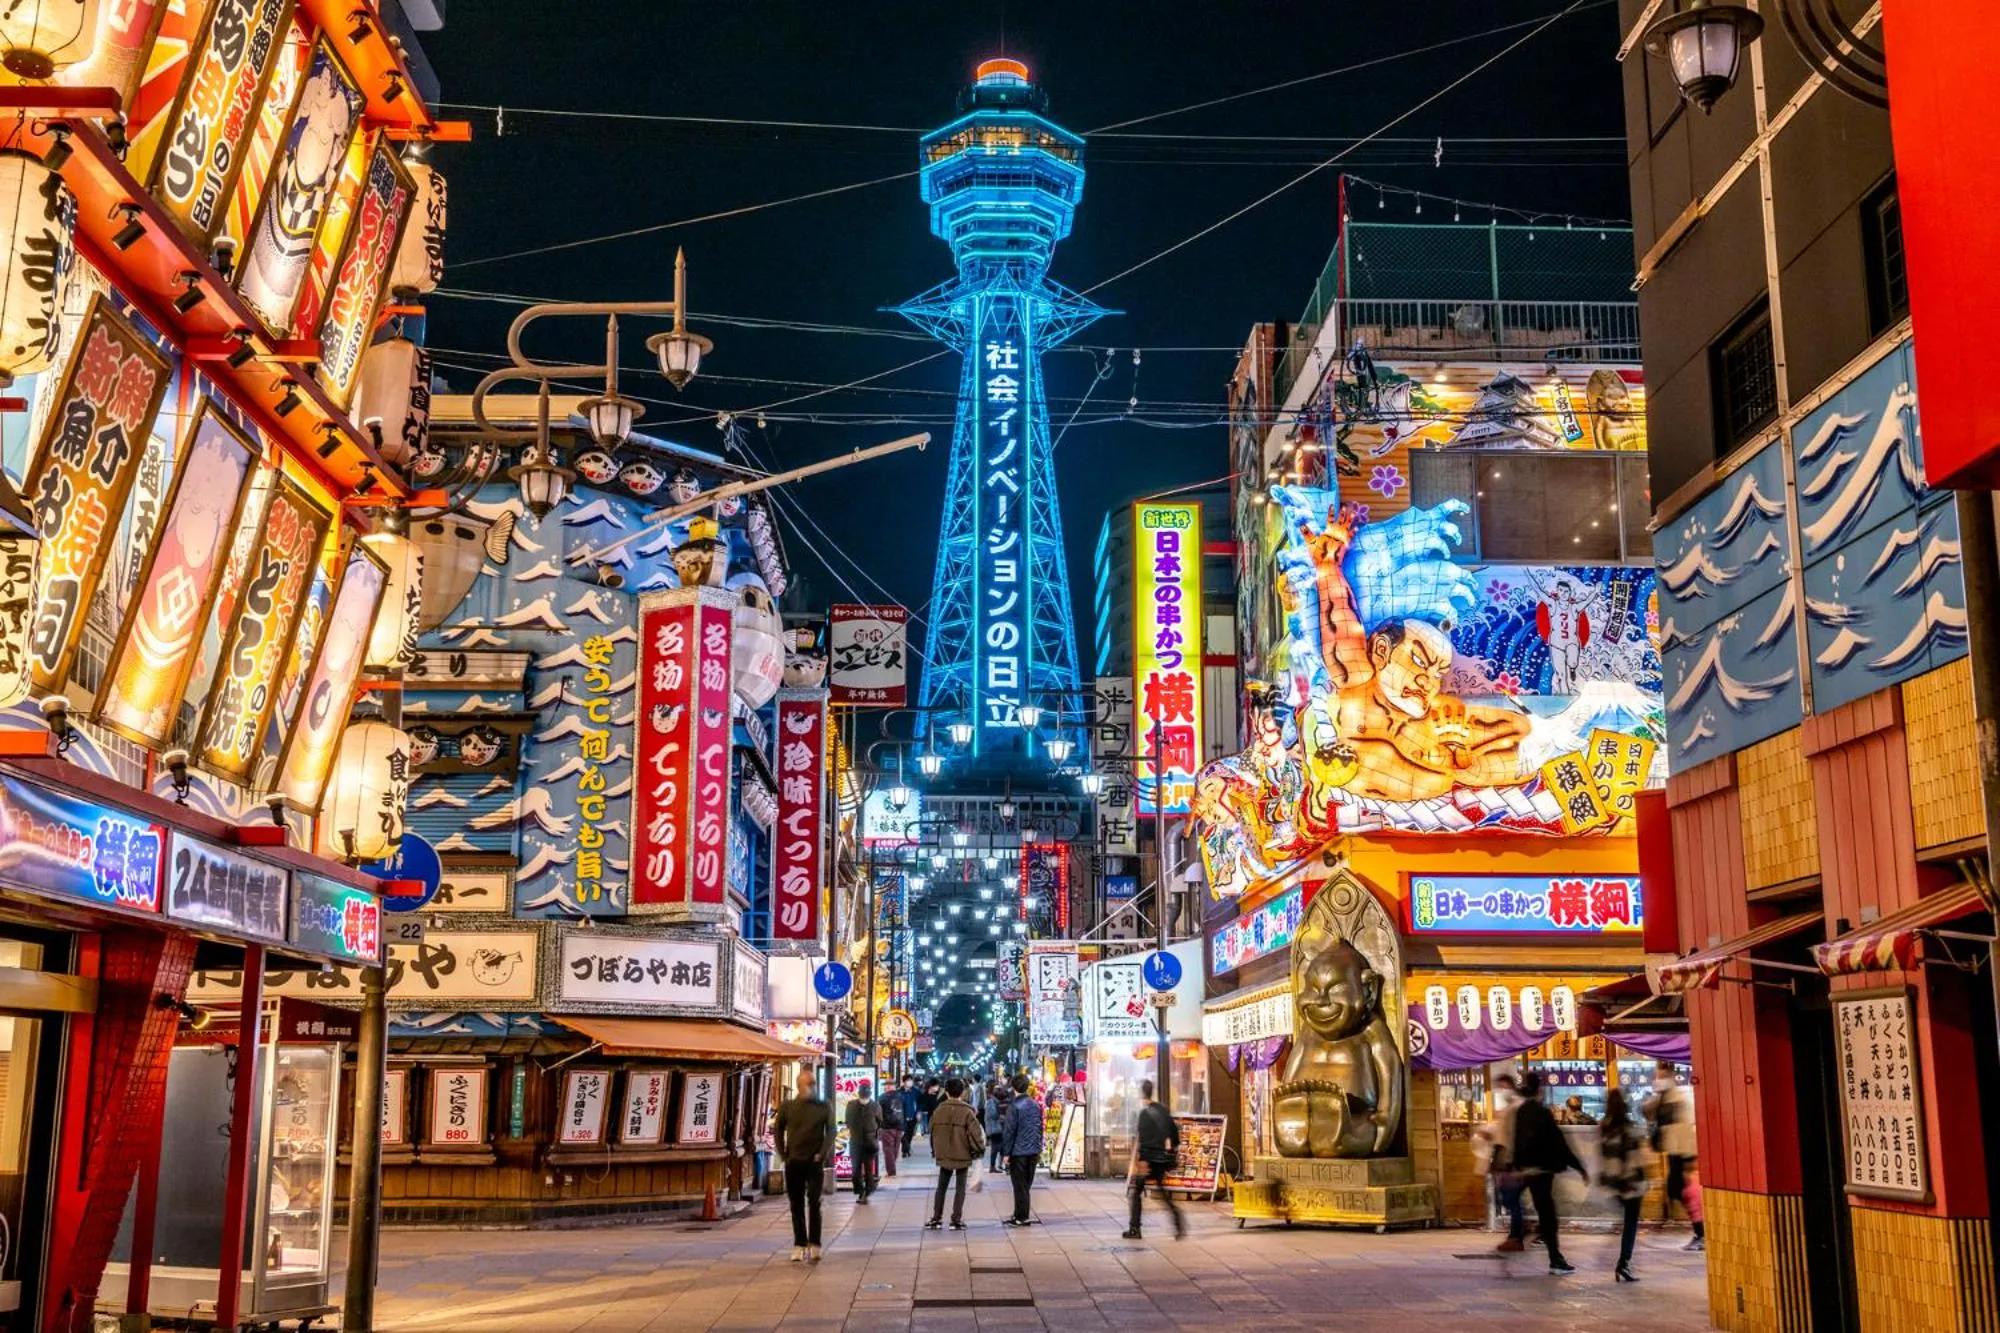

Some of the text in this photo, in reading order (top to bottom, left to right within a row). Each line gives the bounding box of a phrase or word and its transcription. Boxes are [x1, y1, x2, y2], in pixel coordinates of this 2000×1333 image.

[50, 398, 130, 488] 魚介
[985, 340, 1020, 728] 社会イノベーションの日立
[1144, 510, 1191, 529] 新世界
[1155, 531, 1182, 669] 日本一の串かつ
[646, 621, 685, 887] 名物 てっちり
[697, 622, 728, 888] 名物 てっちり
[1144, 671, 1196, 775] 横綱
[576, 634, 614, 903] 安うて何んでも旨い
[1554, 761, 1599, 825] 横綱
[1617, 743, 1642, 810] 日本一の
[93, 817, 162, 906] 横綱
[780, 740, 816, 932] 珍味てっちり
[174, 848, 283, 934] 24時間営業
[1436, 890, 1545, 917] 日本一の串かつ
[1549, 882, 1630, 925] 横綱
[570, 954, 712, 988] づぼらや本店
[1432, 998, 1444, 1024] 串かつ
[1495, 997, 1506, 1024] ホルモン
[296, 1021, 325, 1035] 横綱
[1868, 1005, 1883, 1099] えび天ぷら
[1881, 1004, 1897, 1099] ふくうどん
[1896, 1003, 1911, 1100] ふくかつ丼
[446, 1130, 468, 1139] 880
[646, 1077, 660, 1116] おみやげ
